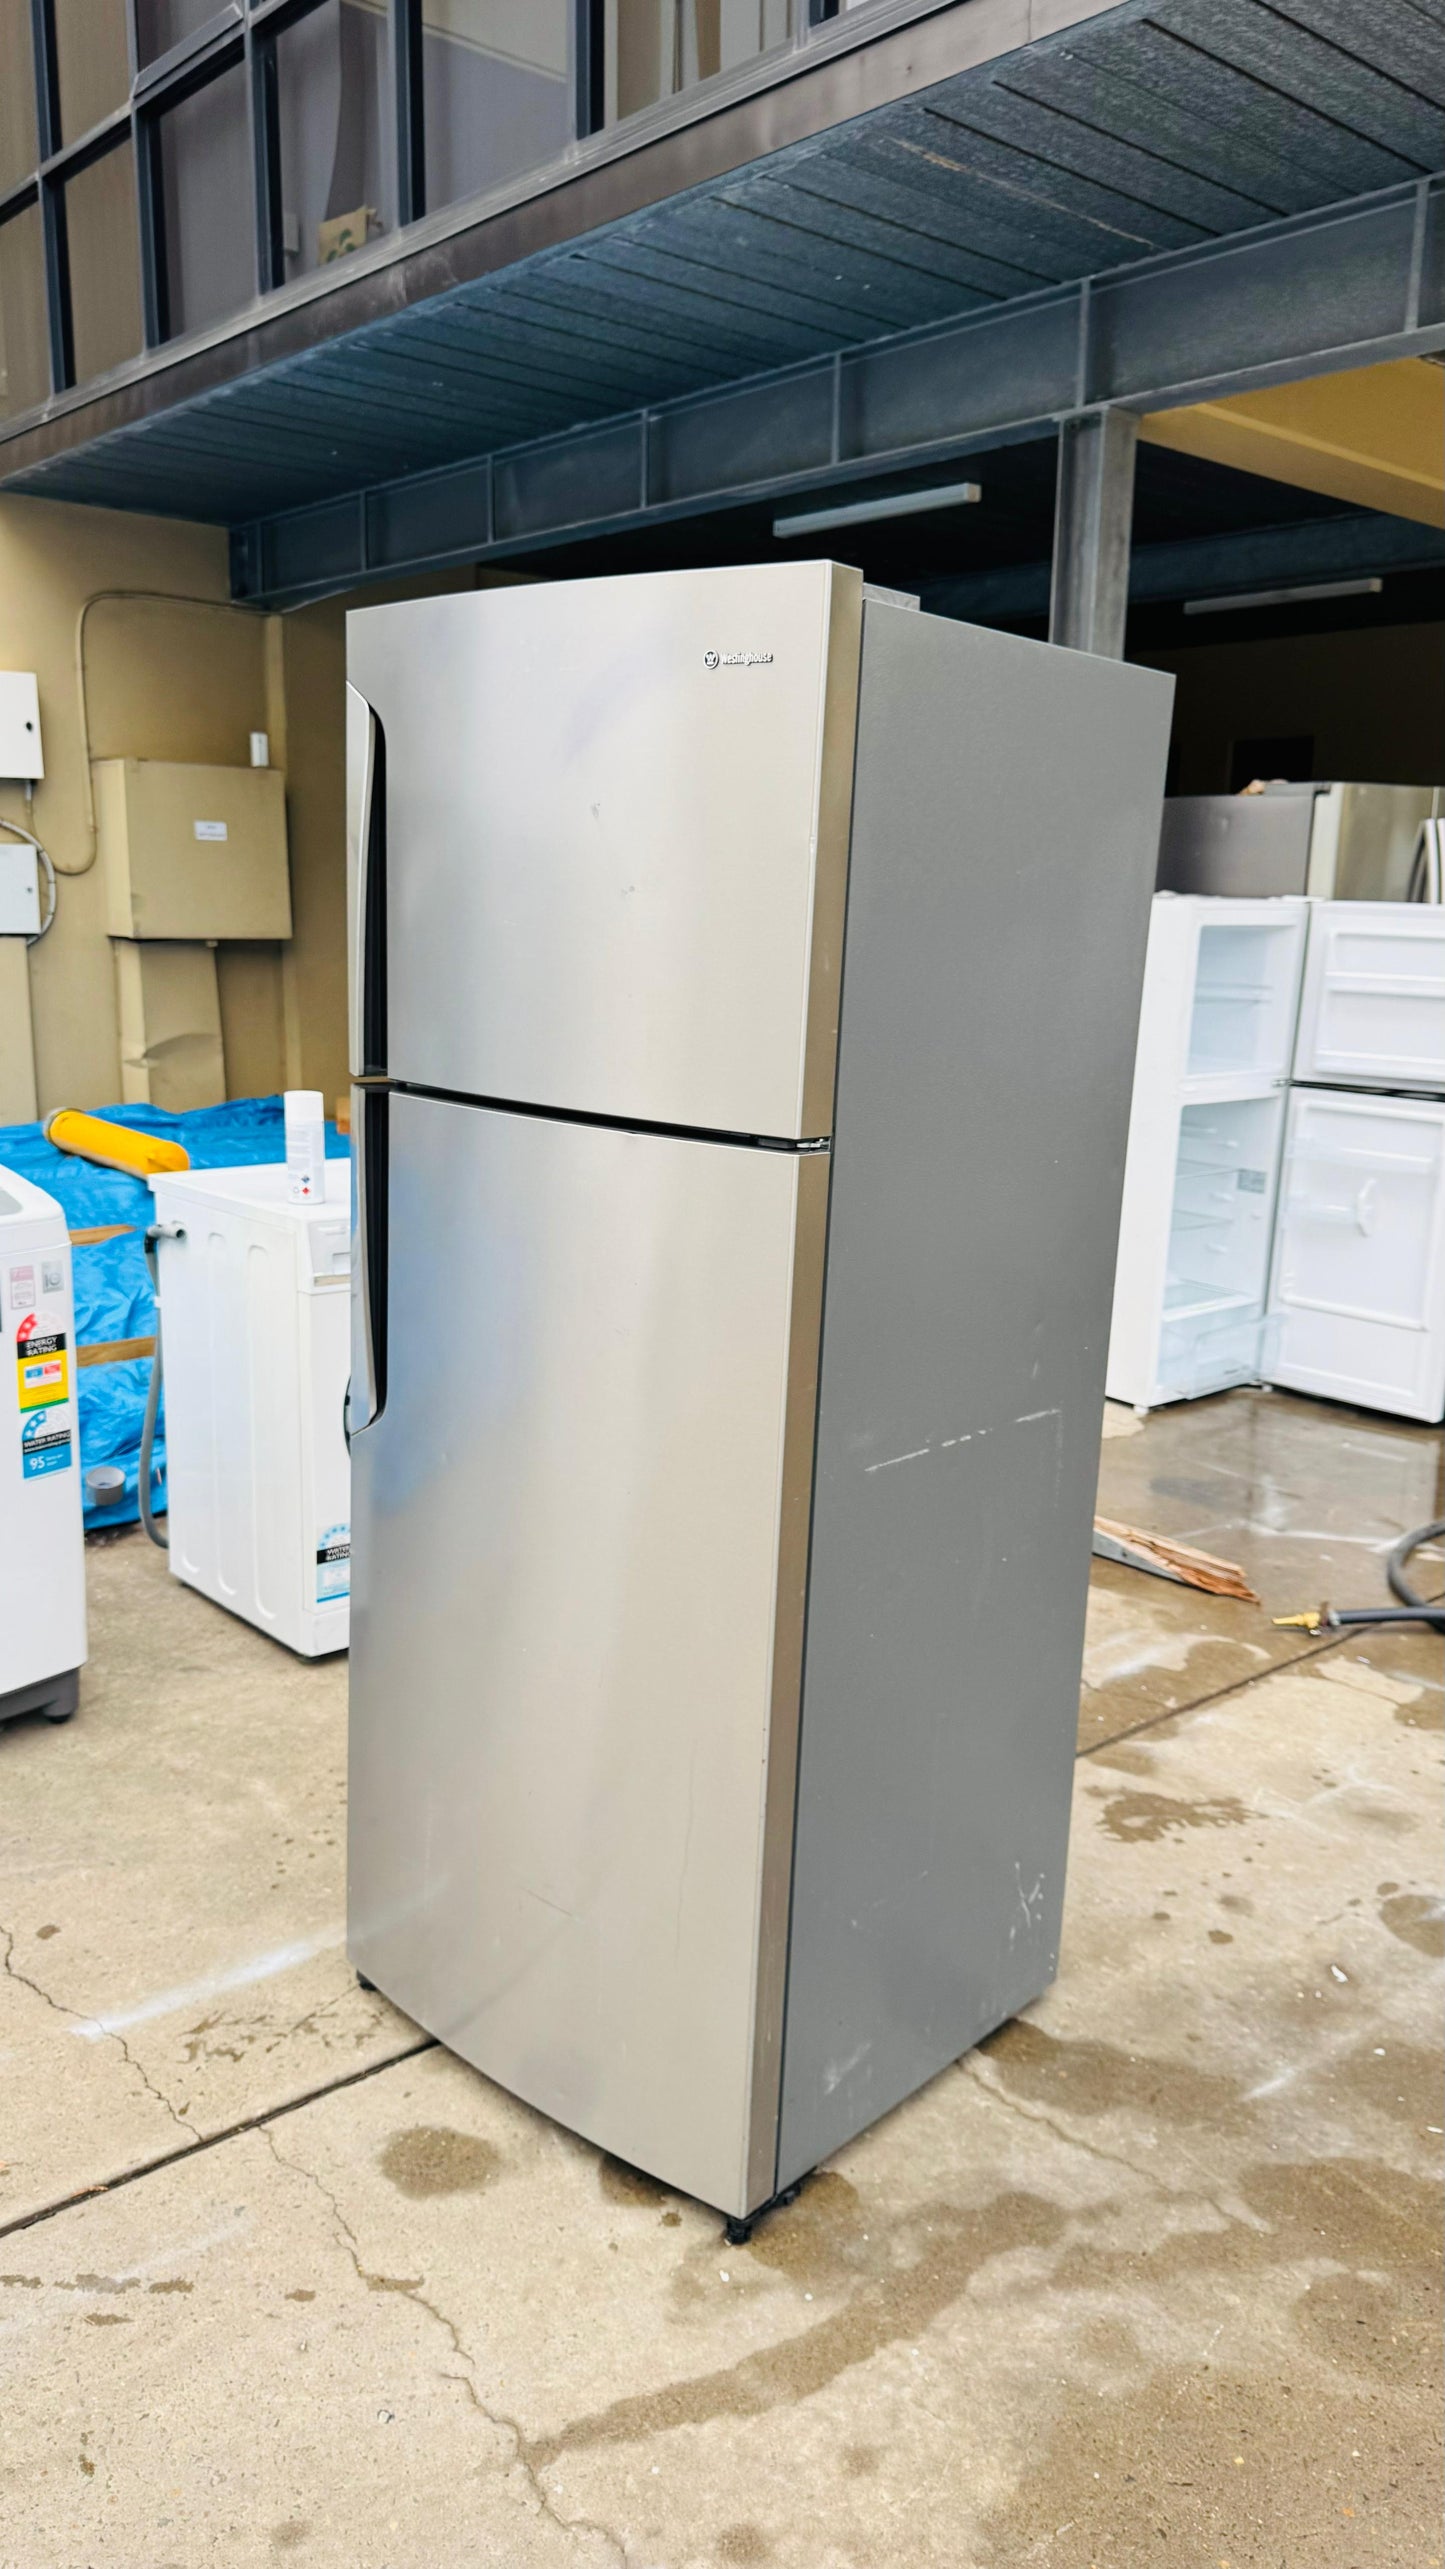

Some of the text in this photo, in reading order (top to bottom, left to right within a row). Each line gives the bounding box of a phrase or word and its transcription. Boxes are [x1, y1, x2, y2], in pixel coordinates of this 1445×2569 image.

[721, 651, 773, 666] Westinghouse
[25, 1336, 57, 1350] ENERGY
[26, 1345, 57, 1356] RATING
[29, 1456, 45, 1470] 95
